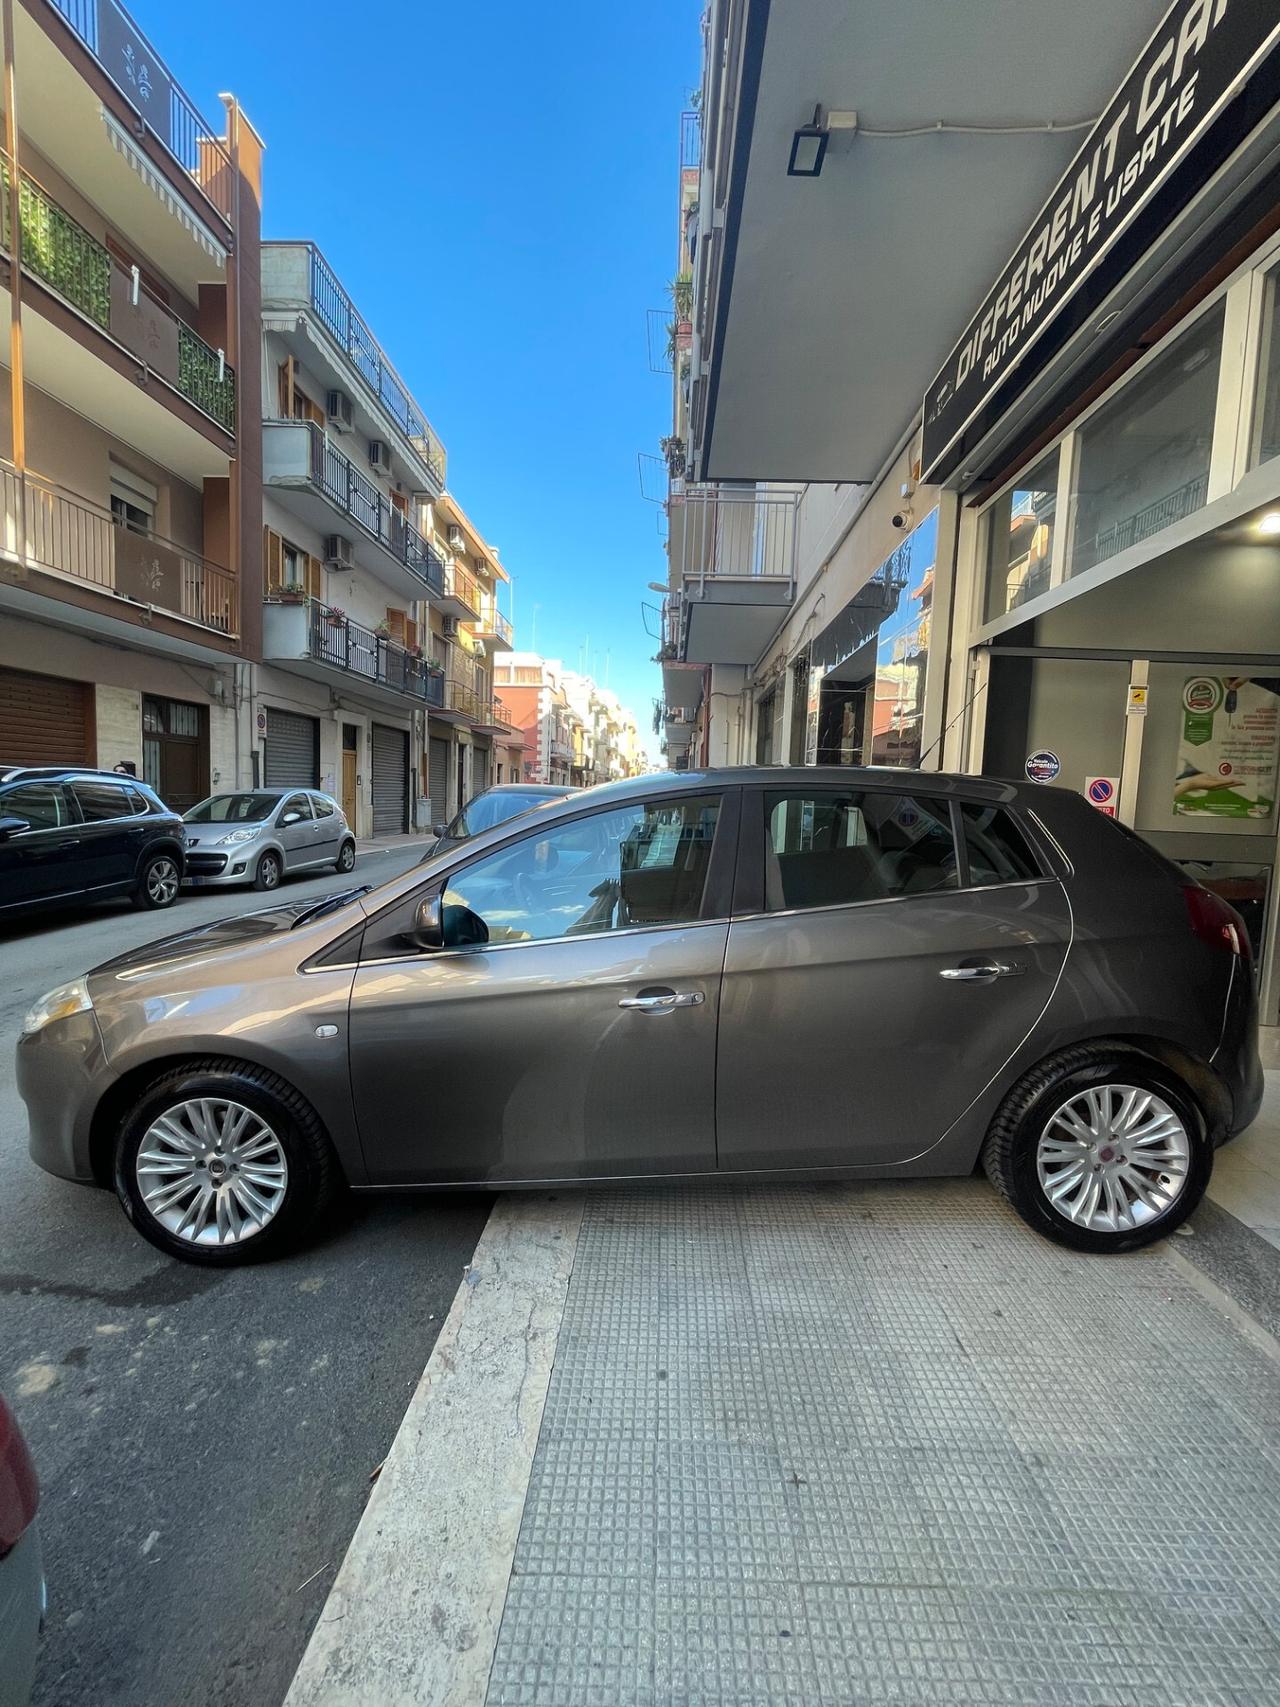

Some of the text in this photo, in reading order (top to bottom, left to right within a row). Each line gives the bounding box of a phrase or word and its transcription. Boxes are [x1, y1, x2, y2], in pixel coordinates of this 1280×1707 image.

[955, 101, 1130, 391] DIFFERENT
[982, 68, 1200, 382] AUTO NUOVE E USATE
[1027, 760, 1059, 769] Garantito
